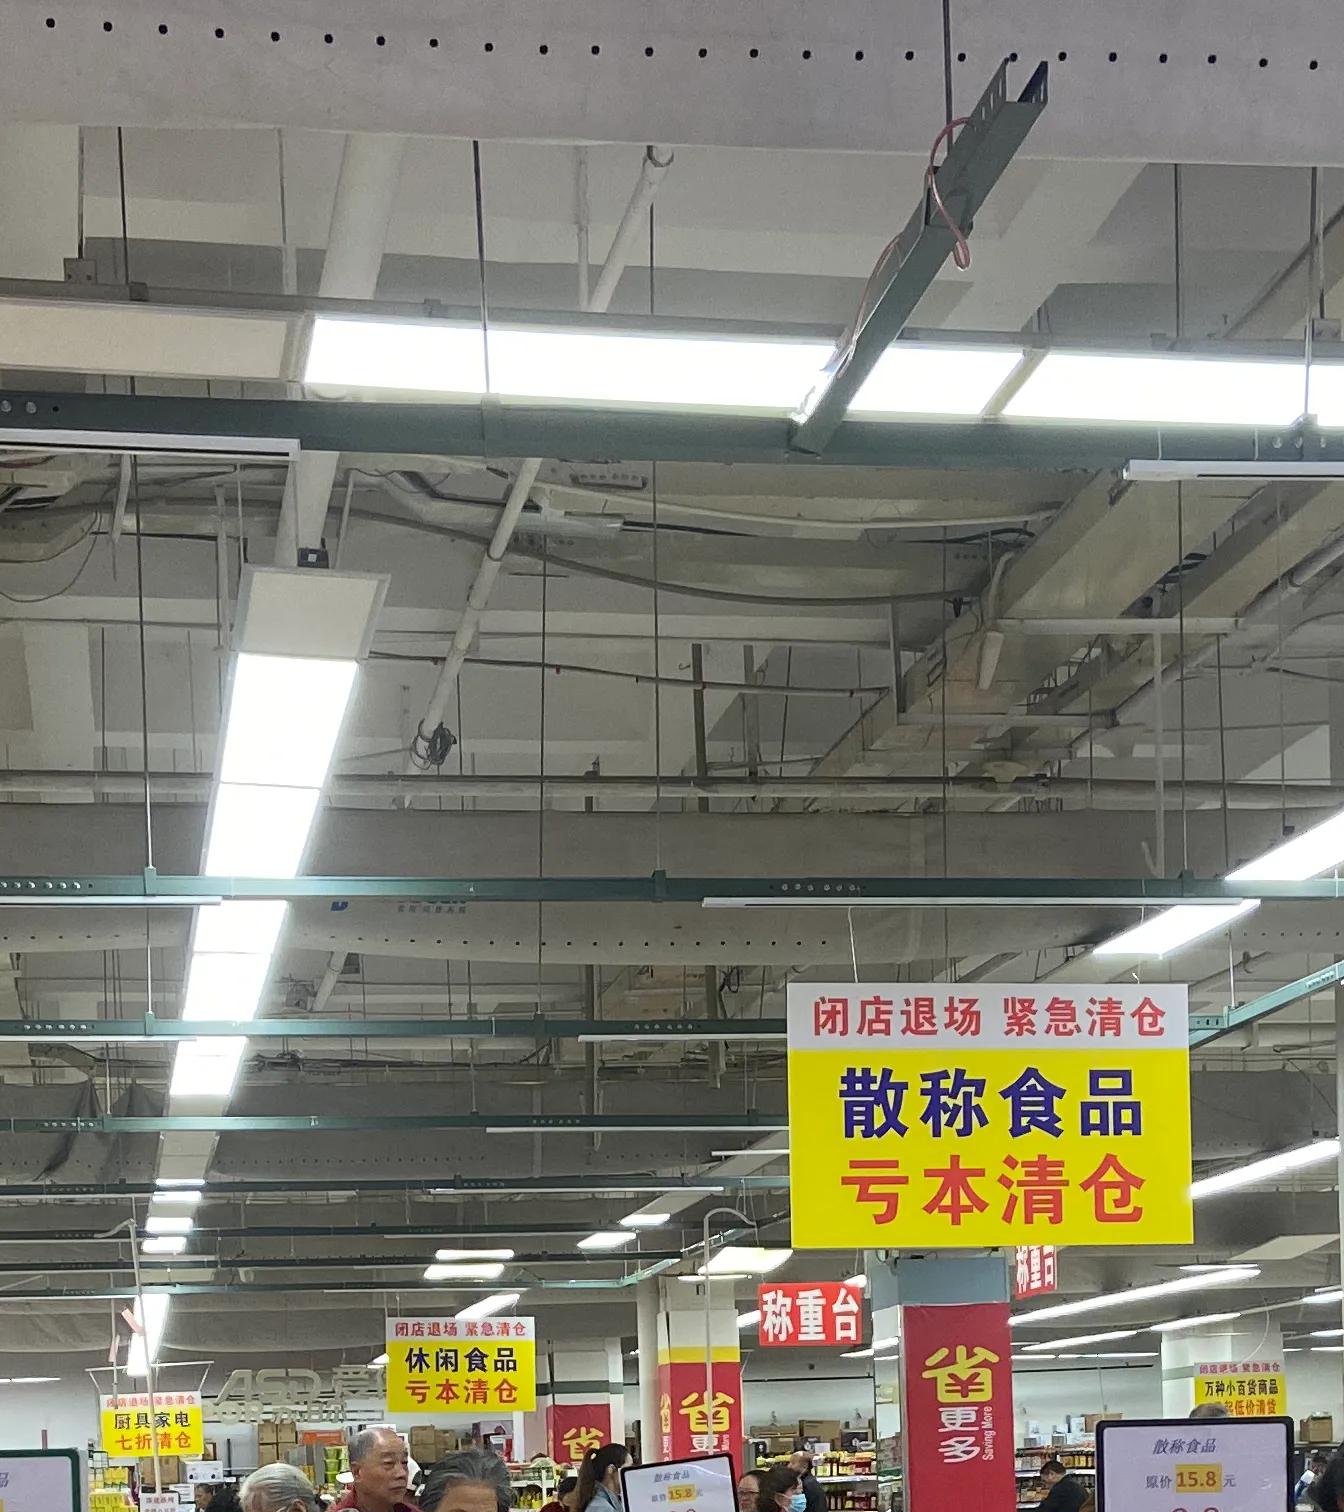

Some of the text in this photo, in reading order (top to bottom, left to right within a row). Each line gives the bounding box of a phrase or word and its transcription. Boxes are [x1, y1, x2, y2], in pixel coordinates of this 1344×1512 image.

[813, 997, 1166, 1037] 闭店退场 紧急清仓
[838, 1066, 1141, 1139] 散称食品
[840, 1153, 1146, 1226] 亏本清仓
[762, 1287, 860, 1342] 称重台
[395, 1321, 526, 1337] 闭店退场 紧急清仓
[405, 1347, 517, 1373] 休闲食品
[216, 1368, 321, 1402] ASD
[405, 1378, 518, 1404] 亏本清仓
[1205, 1379, 1278, 1396] 万种小百货商品
[114, 1410, 191, 1430] 厨具家电
[115, 1431, 192, 1450] 七折清仓
[982, 1406, 996, 1461] Saving More
[1152, 1437, 1217, 1455] 散称食品
[1145, 1471, 1237, 1489] 原价 15.8 元
